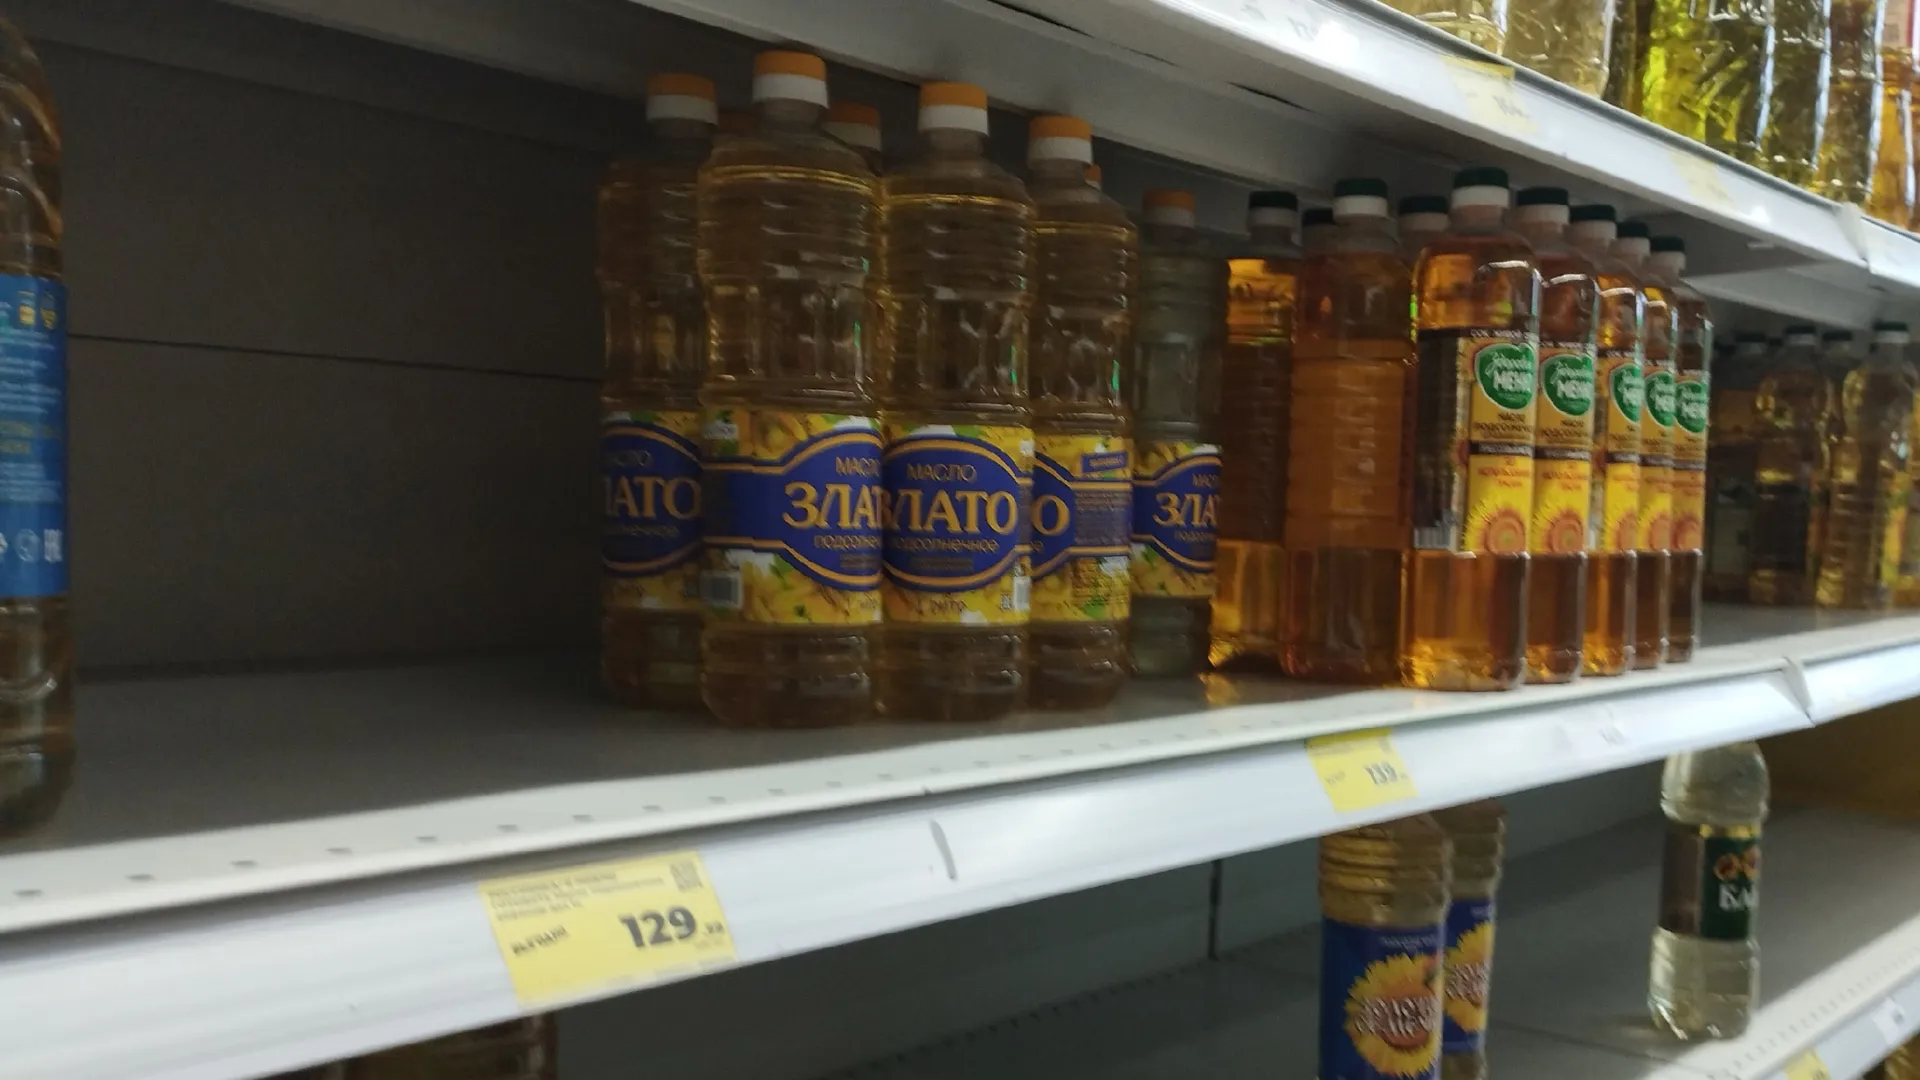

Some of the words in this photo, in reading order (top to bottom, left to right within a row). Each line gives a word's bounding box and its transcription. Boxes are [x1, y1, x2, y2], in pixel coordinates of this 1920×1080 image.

[1557, 380, 1594, 400] МЕН
[907, 463, 977, 482] МАСЛО
[604, 476, 701, 521] АТО
[1153, 491, 1217, 528] ЗЛА
[618, 906, 698, 948] 129
